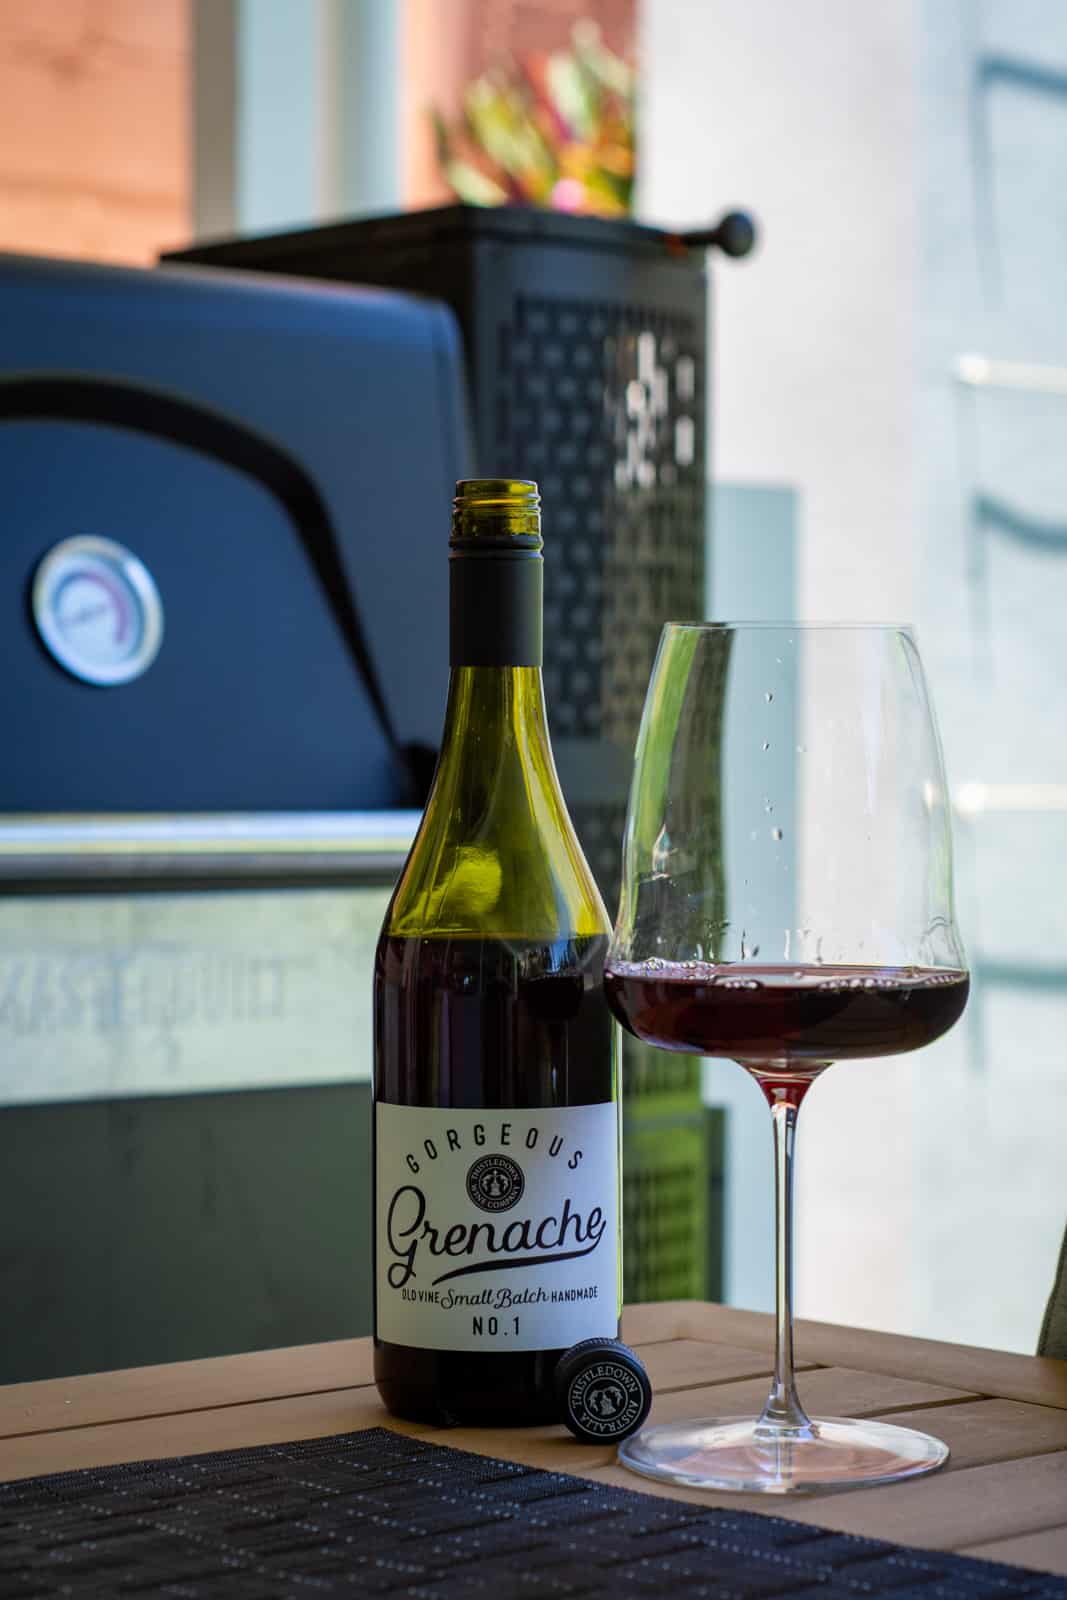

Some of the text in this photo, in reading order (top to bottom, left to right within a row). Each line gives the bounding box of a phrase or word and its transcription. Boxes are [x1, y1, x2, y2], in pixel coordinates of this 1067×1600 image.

[406, 1123, 583, 1174] GORGEOUS
[387, 1185, 606, 1289] Grenache
[402, 1286, 599, 1309] OLD VINE Small Batch HANDMADE
[472, 1316, 520, 1336] NO.1
[571, 1366, 639, 1409] THISTLEDOWN
[580, 1399, 639, 1433] AUSTRALIA
